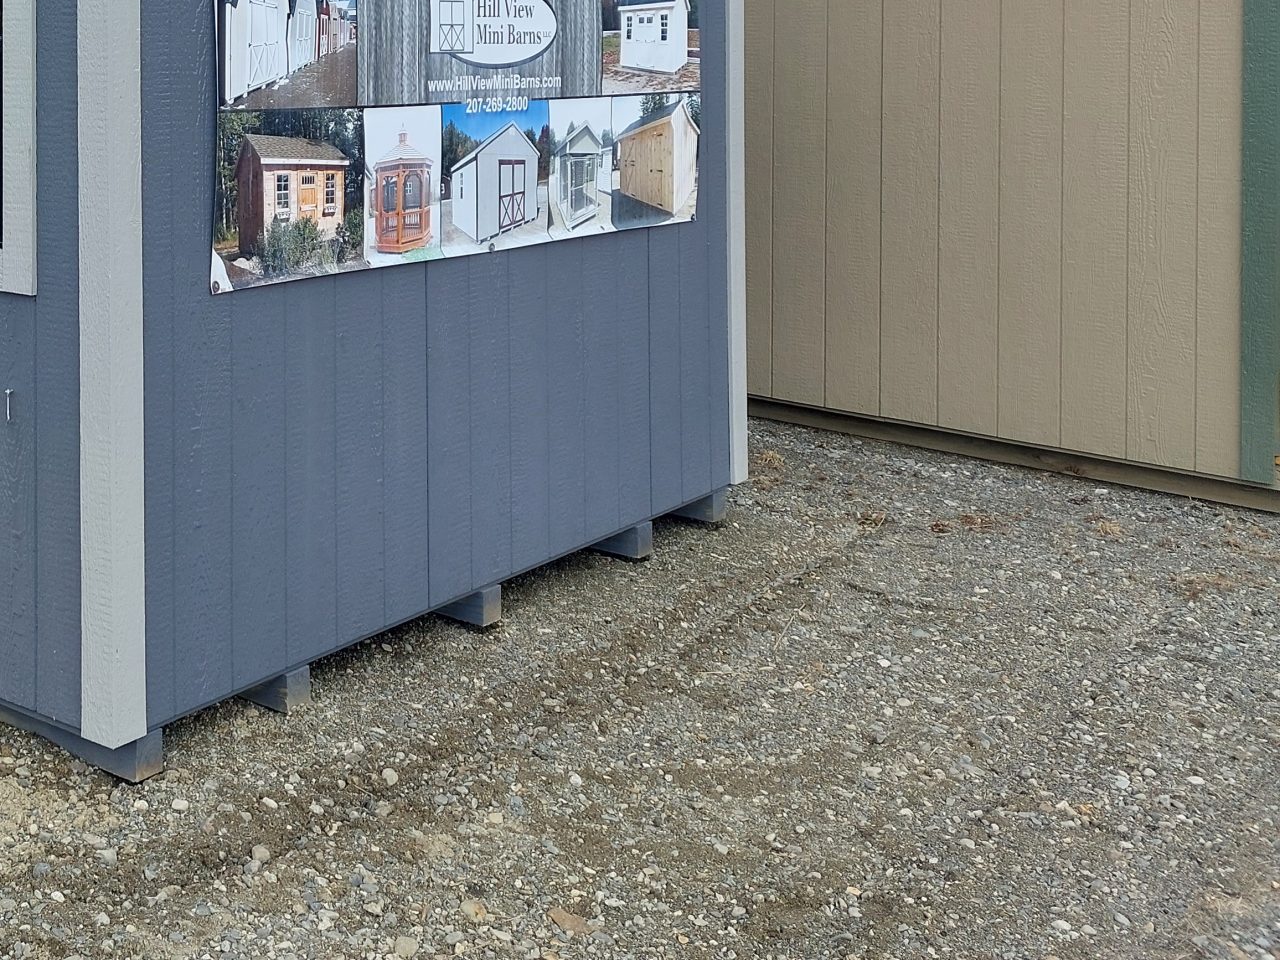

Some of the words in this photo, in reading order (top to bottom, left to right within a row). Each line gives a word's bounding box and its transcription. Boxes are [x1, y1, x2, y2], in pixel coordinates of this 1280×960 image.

[476, 23, 504, 45] Mini
[507, 24, 542, 45] Barns
[427, 74, 562, 92] www.HillViewMiniBarns.com
[465, 96, 528, 113] 207-269-2800
